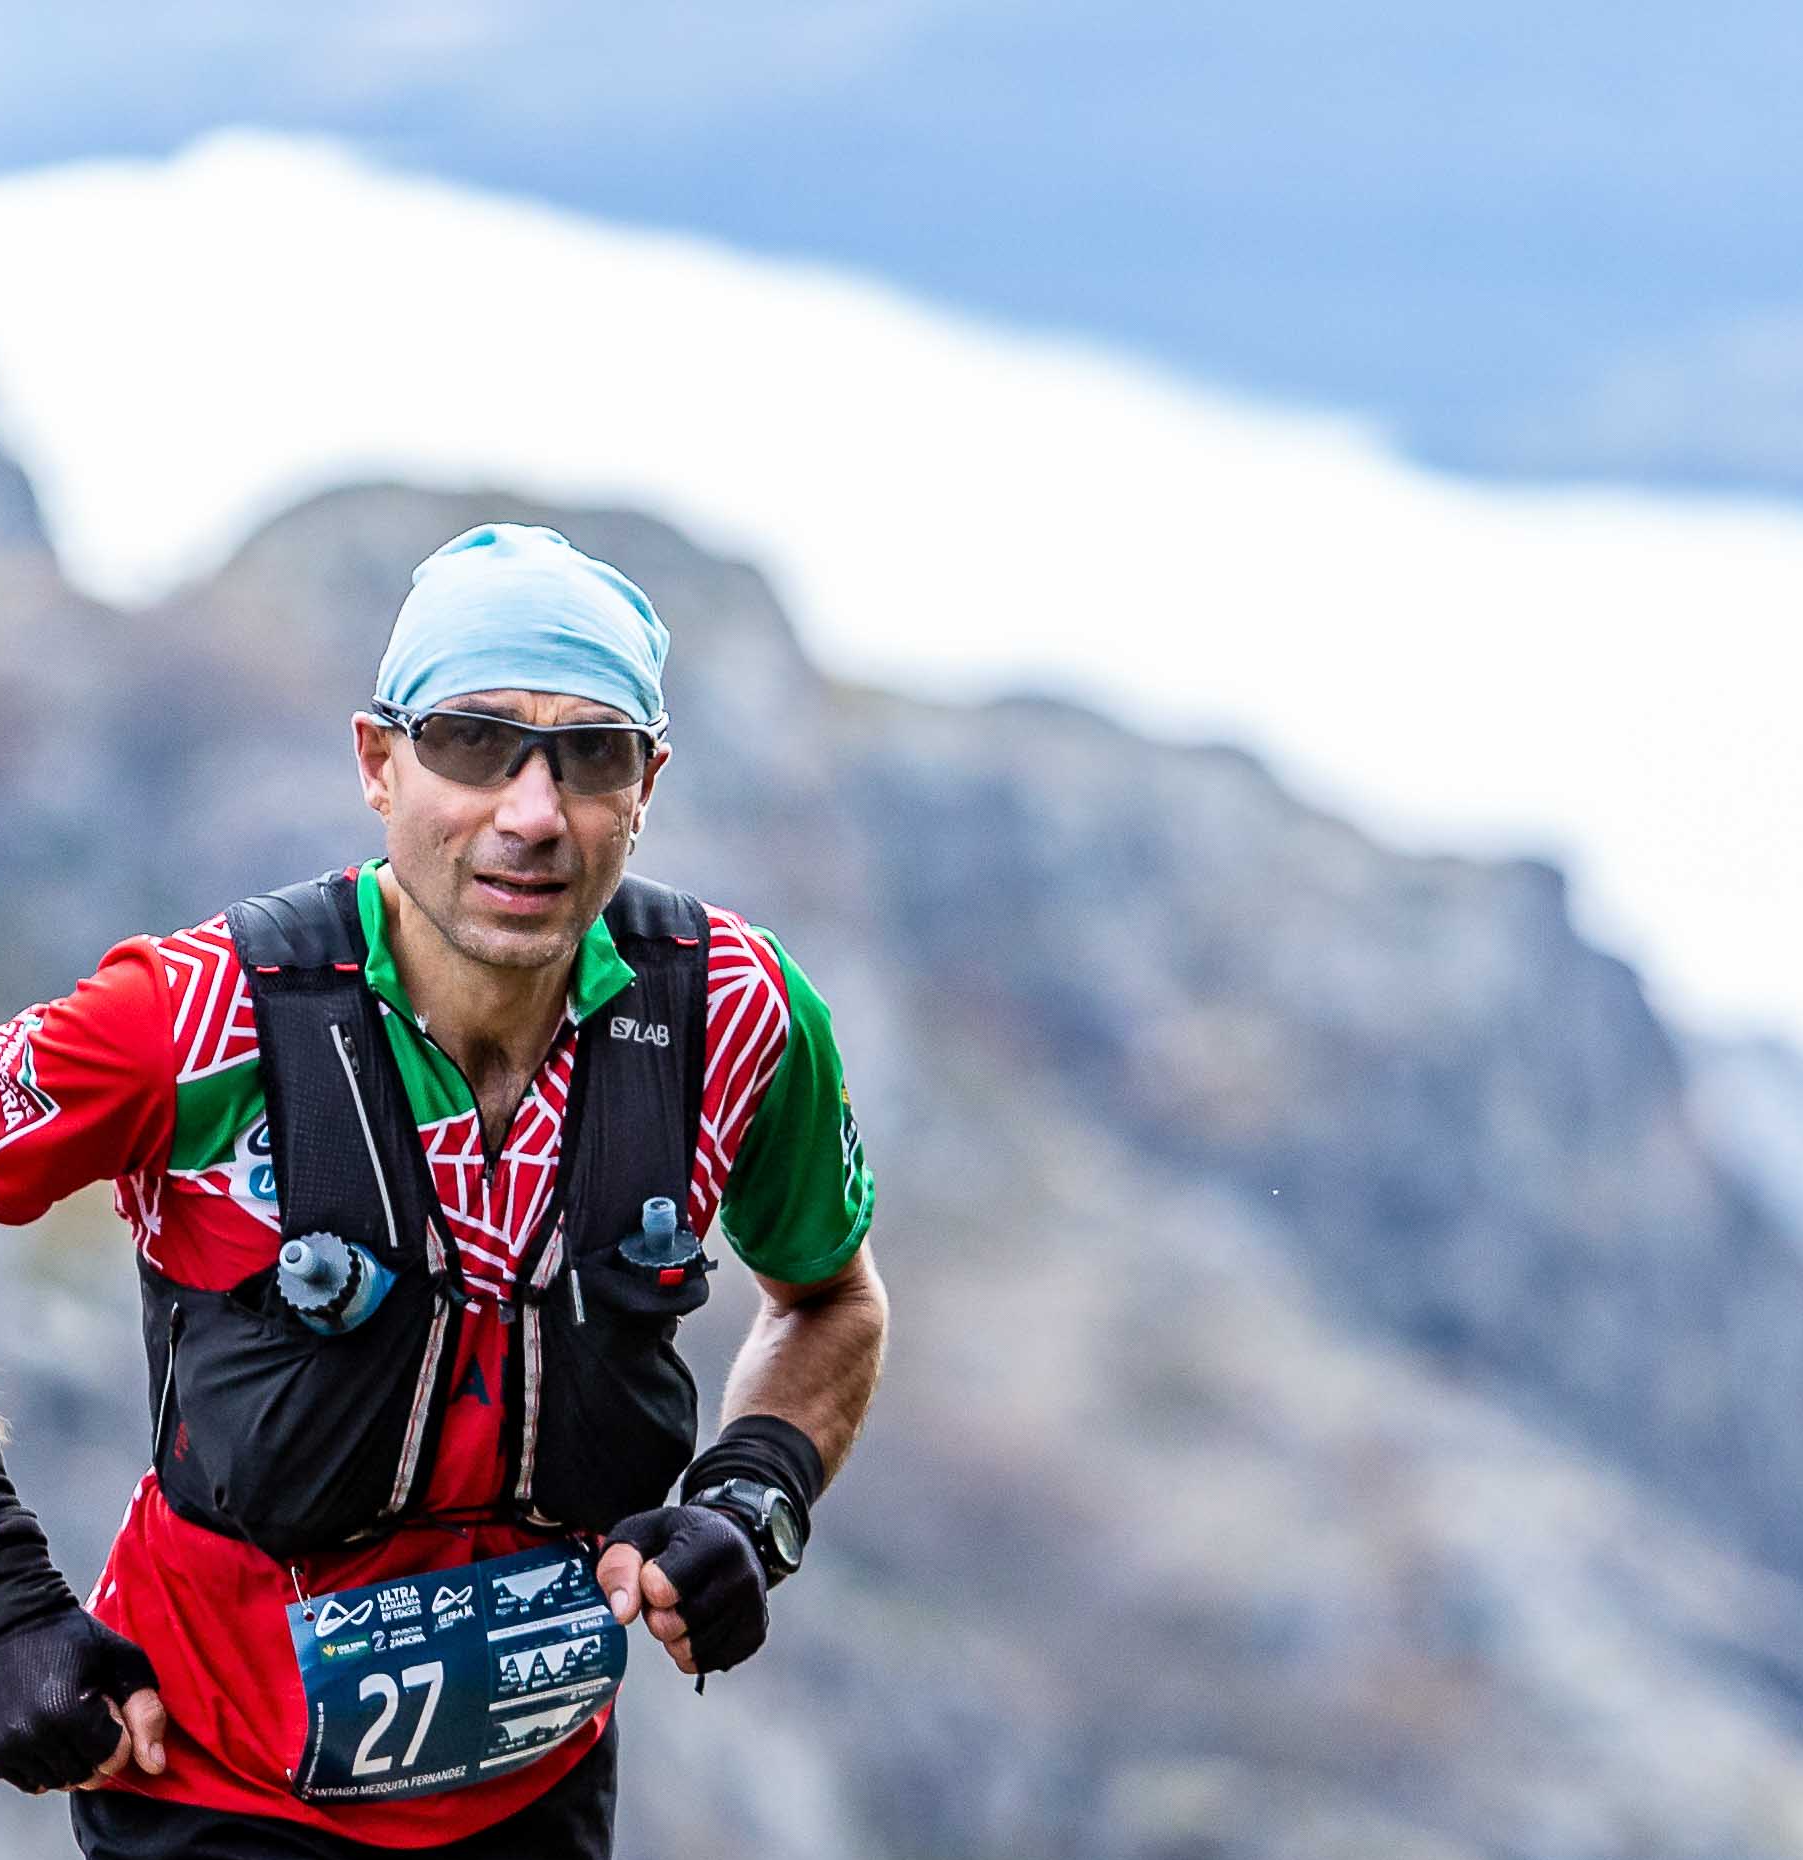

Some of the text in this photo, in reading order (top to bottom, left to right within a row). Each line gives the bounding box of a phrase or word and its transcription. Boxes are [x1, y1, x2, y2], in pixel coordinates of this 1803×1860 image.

[377, 1585, 420, 1604] ULTRA
[352, 1660, 444, 1777] 27
[308, 1765, 467, 1797] SANTIAGO MEZQUITA FERNANDEZ
